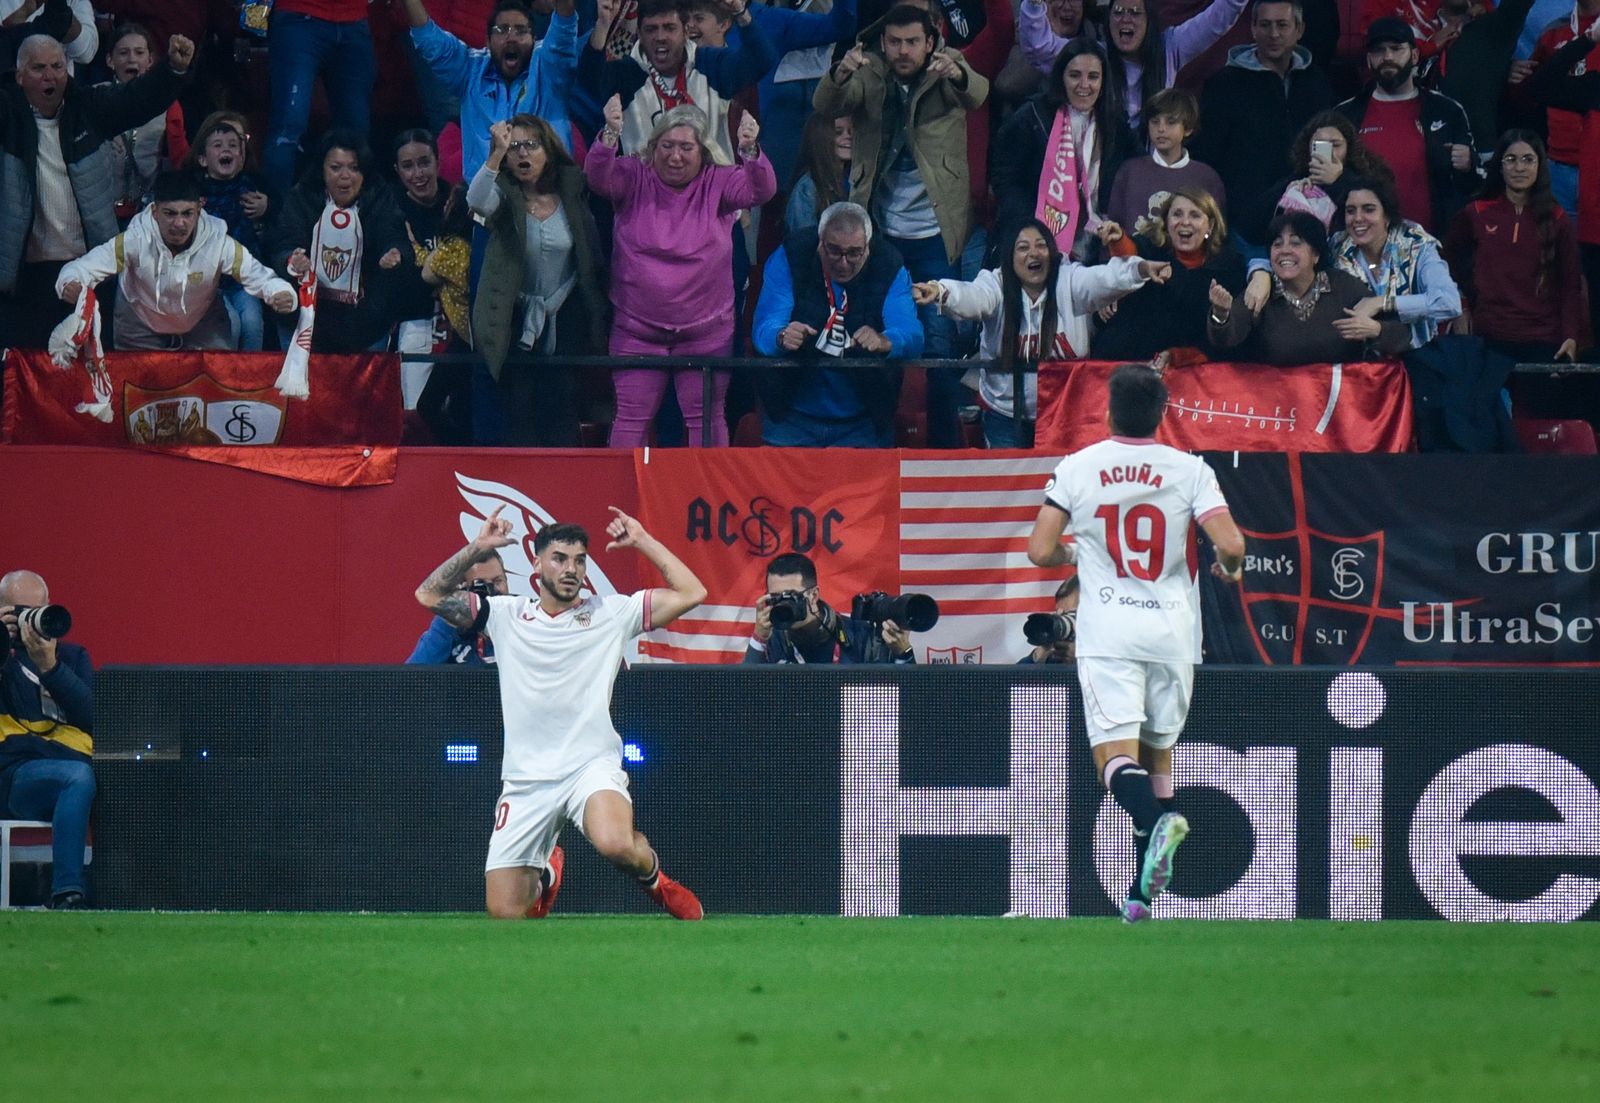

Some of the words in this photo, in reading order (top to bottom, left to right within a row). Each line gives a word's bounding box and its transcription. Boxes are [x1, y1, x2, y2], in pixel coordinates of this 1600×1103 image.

[1166, 397, 1255, 415] evilla
[1275, 406, 1297, 419] FC
[1099, 463, 1164, 489] ACUÑA
[686, 497, 739, 547] AC
[790, 506, 845, 555] DC
[1094, 503, 1166, 583] 19
[1476, 531, 1600, 574] GRU
[1399, 601, 1600, 644] UltraSe
[840, 672, 1600, 923] Haie
